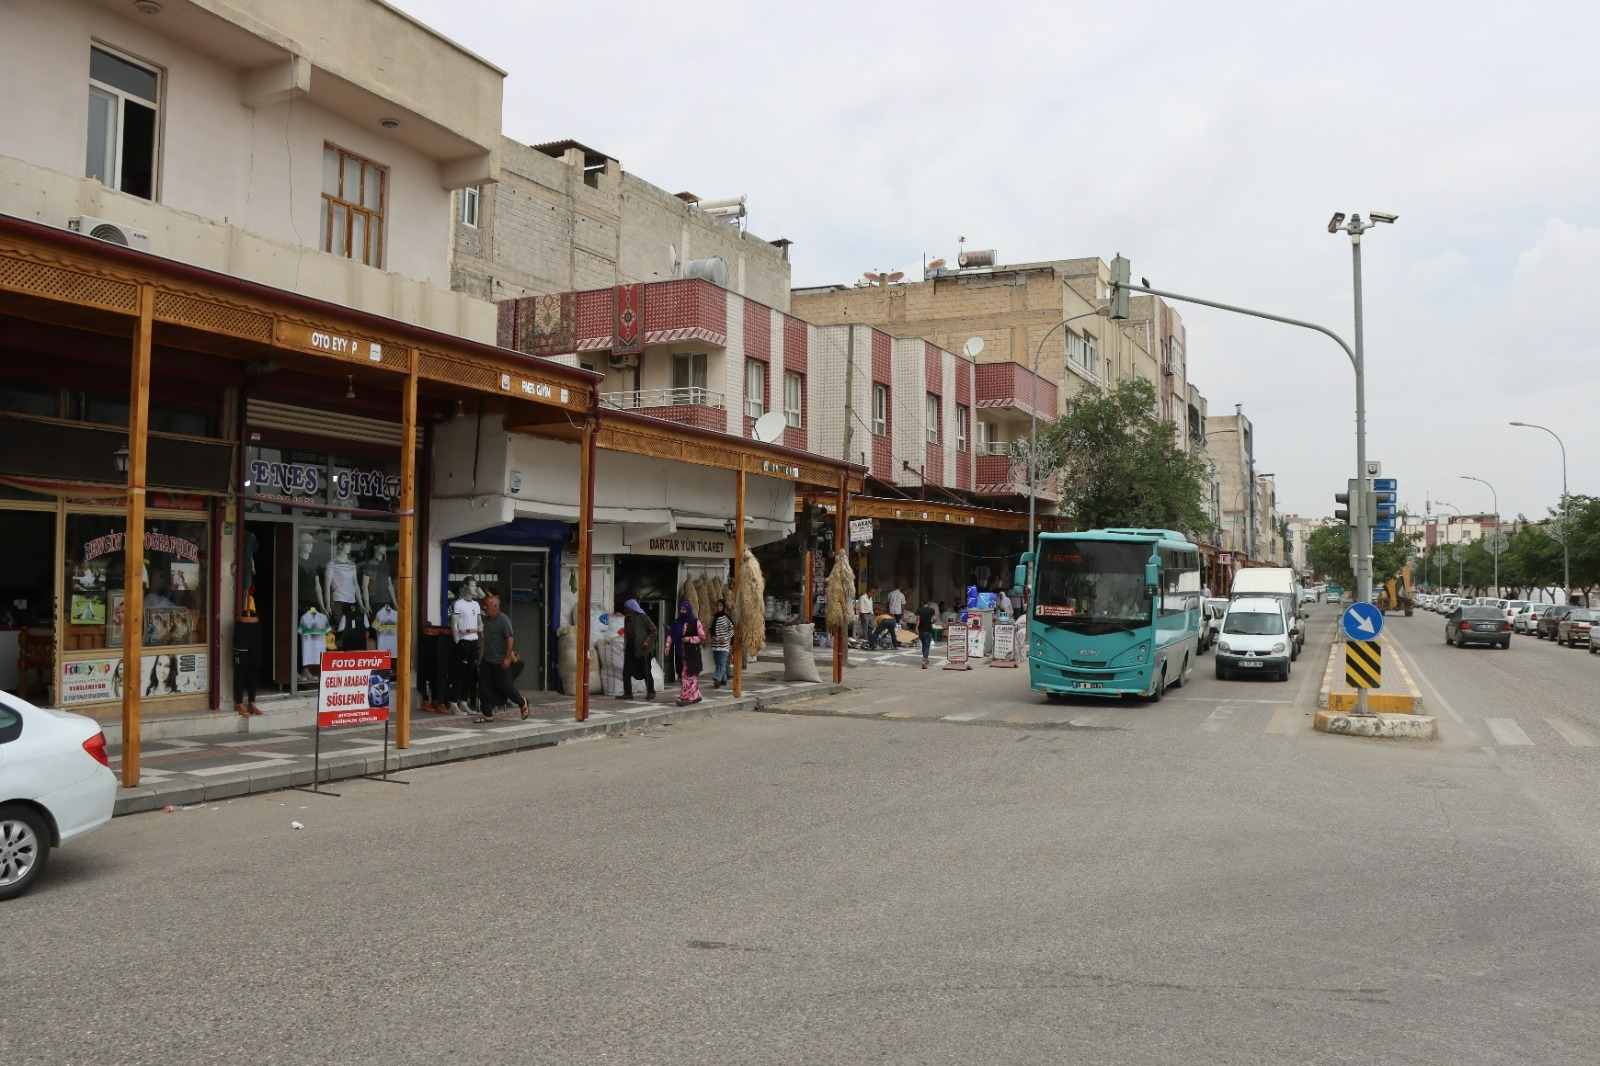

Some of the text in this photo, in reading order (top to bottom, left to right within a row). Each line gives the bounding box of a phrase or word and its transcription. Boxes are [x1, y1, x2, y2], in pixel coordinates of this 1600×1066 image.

[251, 460, 318, 494] ENES
[649, 537, 724, 553] DARTAR YÜN TİCARET
[332, 656, 382, 668] FOTO EYYÜP
[326, 674, 368, 688] GELİN ARABASI
[326, 691, 365, 707] SÜSLENİR
